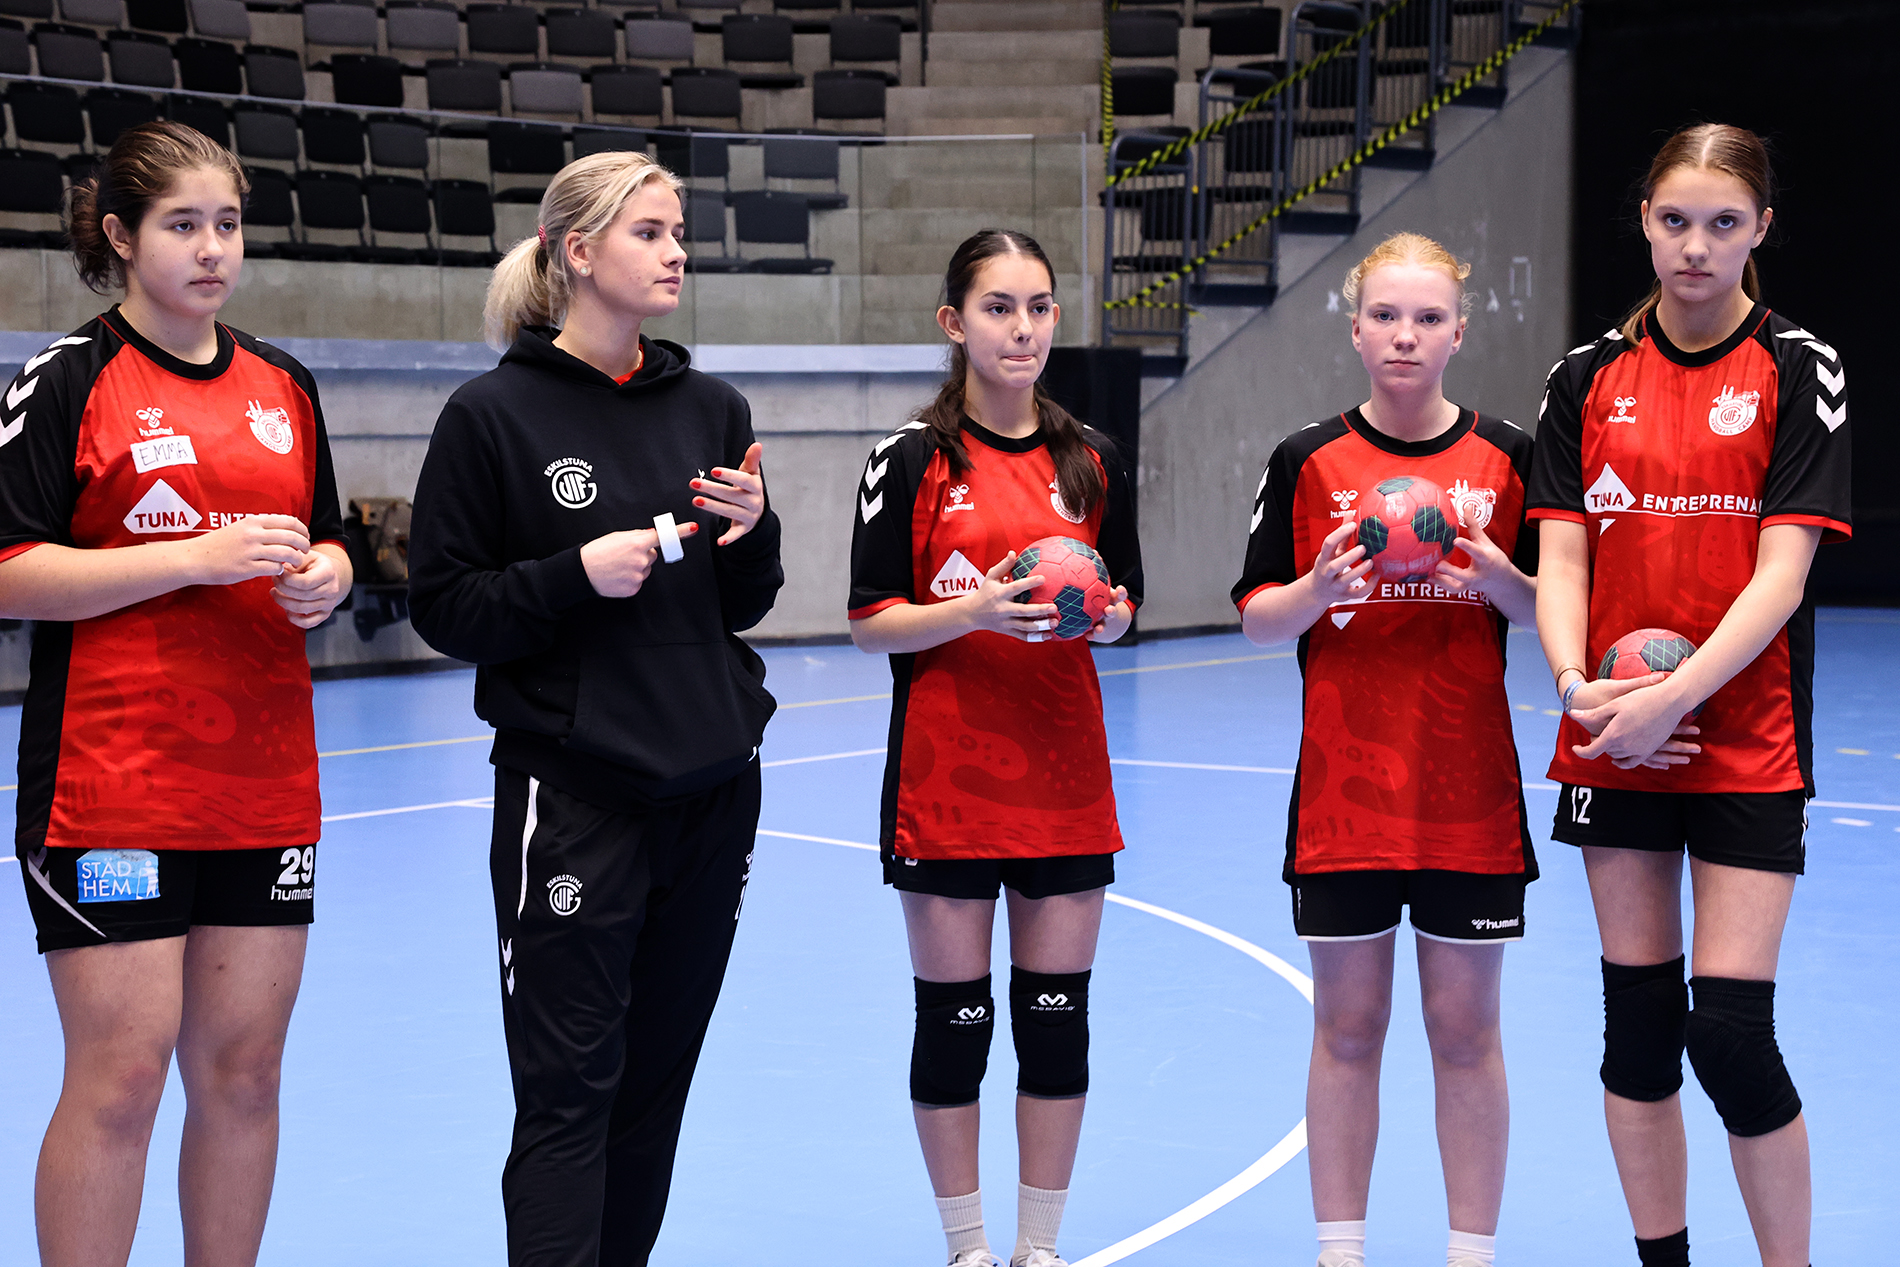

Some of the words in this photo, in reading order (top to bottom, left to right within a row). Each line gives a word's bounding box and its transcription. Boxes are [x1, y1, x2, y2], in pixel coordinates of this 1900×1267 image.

[139, 441, 188, 466] EMMA
[543, 457, 593, 477] ESKILSTUNA
[134, 511, 189, 528] TUNA
[1571, 785, 1592, 825] 12
[81, 858, 132, 880] STÄD
[276, 846, 314, 885] 29
[83, 878, 132, 898] HEM
[546, 874, 583, 889] ESKILSTUNA
[1486, 916, 1519, 930] hummel
